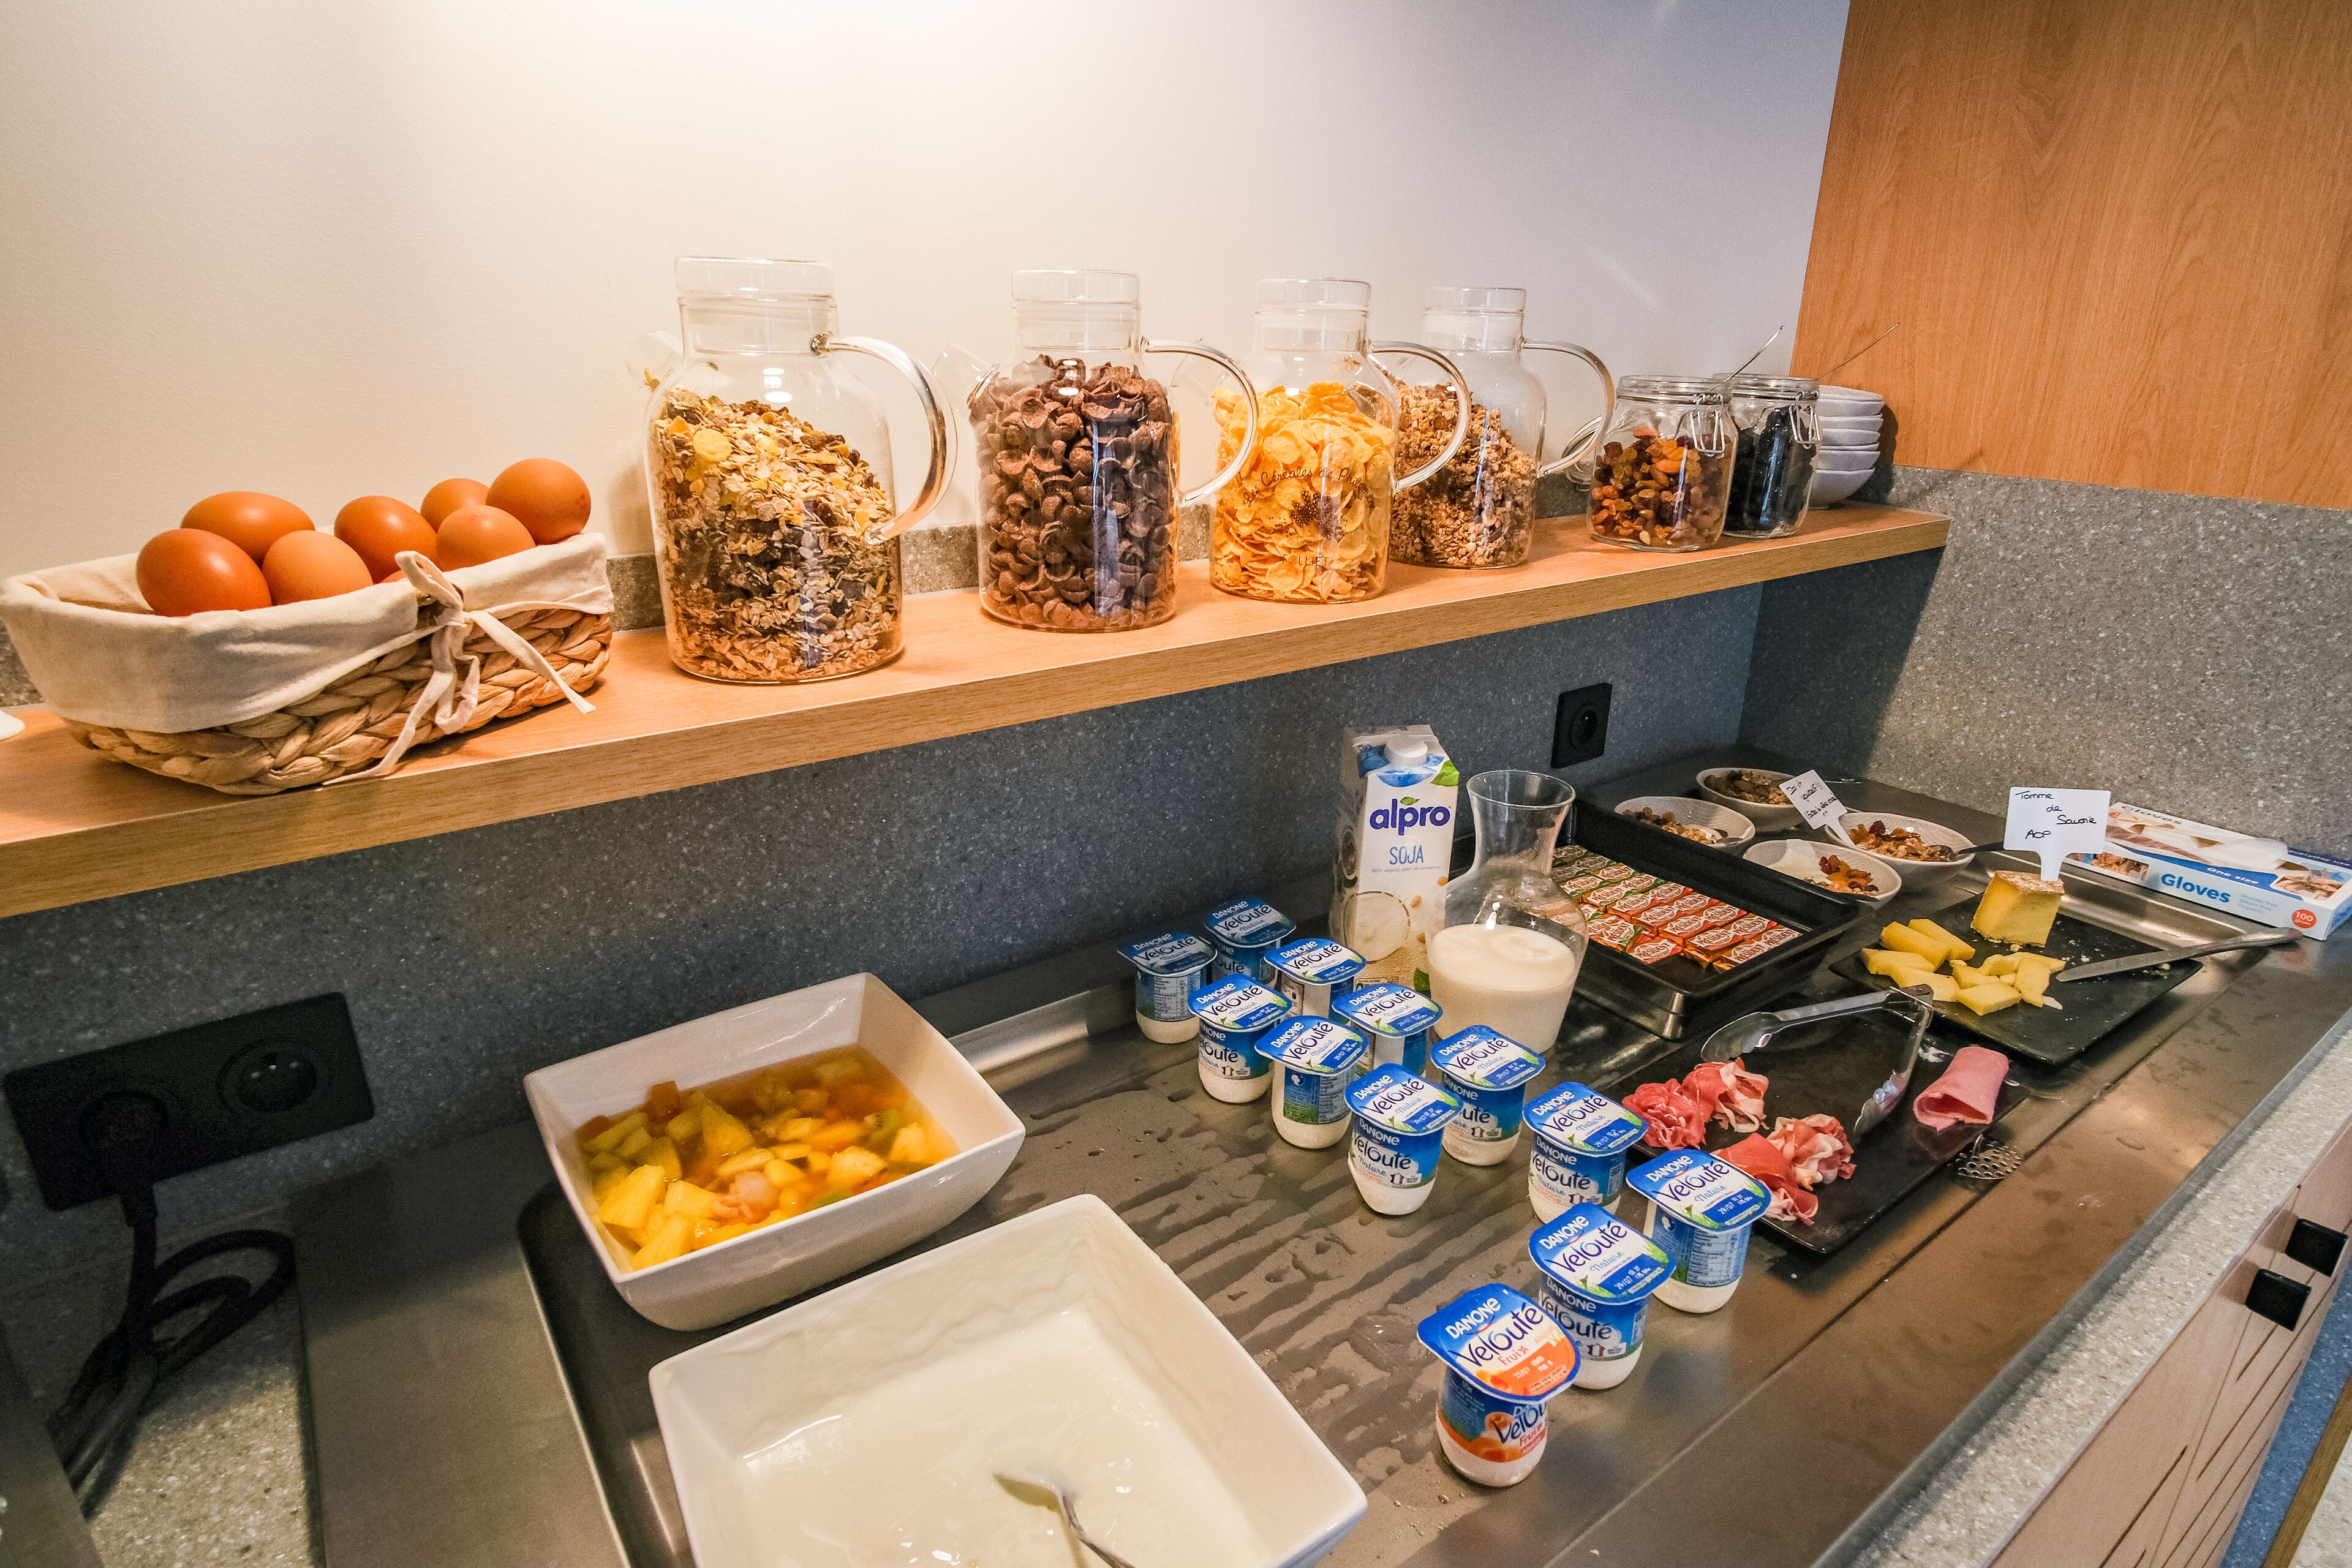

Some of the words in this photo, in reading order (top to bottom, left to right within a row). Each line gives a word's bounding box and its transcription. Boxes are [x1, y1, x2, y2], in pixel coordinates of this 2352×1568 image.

[1261, 466, 1313, 486] Céréales
[1370, 799, 1450, 835] alpro
[2056, 815, 2097, 825] Savoie
[2121, 806, 2182, 825] Gloves
[2025, 829, 2051, 839] AOP
[1389, 845, 1423, 865] SOJA
[2207, 867, 2231, 876] One
[2234, 875, 2259, 884] size
[2161, 873, 2231, 903] Gloves
[1212, 901, 1248, 919] DANONE
[2296, 911, 2313, 922] 100
[1133, 933, 1173, 951] DANONE
[1280, 941, 1318, 959] DANONE
[1196, 983, 1236, 1004] DANONE
[1349, 986, 1389, 1006] DANONE
[1229, 1001, 1258, 1016] Nature
[1270, 1022, 1305, 1048] DANONE
[1439, 1034, 1479, 1056] DANONE
[1311, 1038, 1334, 1057] Nature
[1353, 1075, 1393, 1100] DANONE
[1395, 1098, 1423, 1114] Nature
[1532, 1090, 1575, 1116] DANONE
[1359, 1118, 1400, 1145] DANONE
[1576, 1115, 1606, 1131] Nature
[1536, 1136, 1577, 1166] DANONE
[1358, 1155, 1387, 1177] Nature
[1646, 1155, 1694, 1183] DANONE
[1536, 1174, 1565, 1195] Nature
[1695, 1185, 1728, 1202] Nature
[1539, 1215, 1590, 1250] DANONE
[1589, 1251, 1625, 1272] Nature
[1547, 1276, 1596, 1313] DANONE
[1445, 1297, 1501, 1339] DANONE
[1498, 1346, 1529, 1366] Fruix
